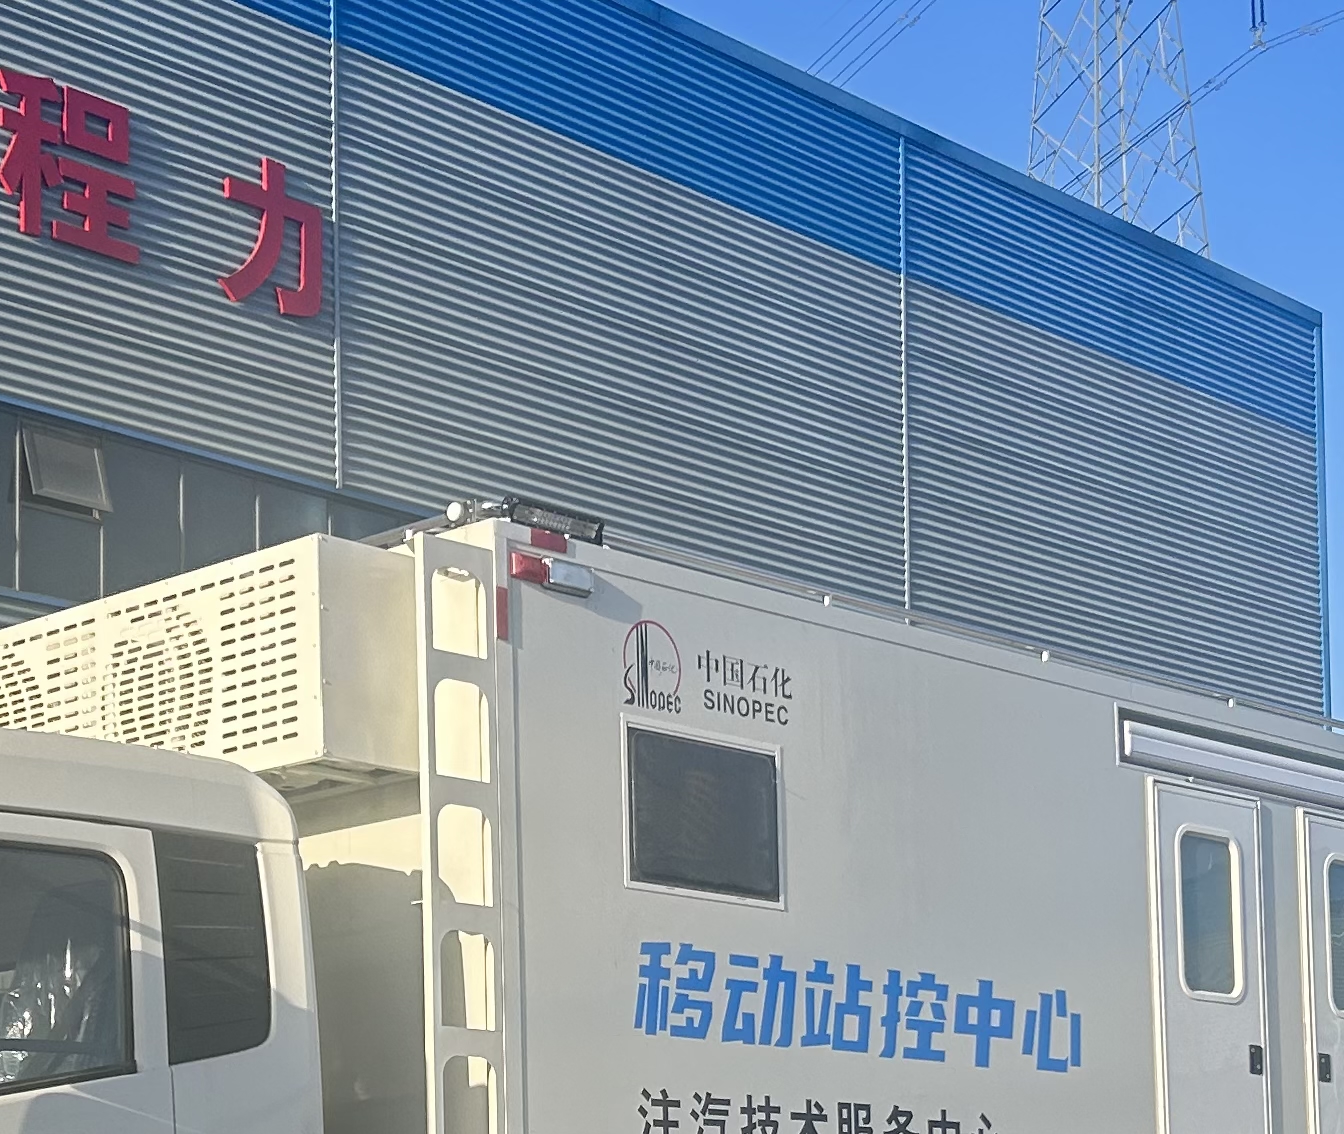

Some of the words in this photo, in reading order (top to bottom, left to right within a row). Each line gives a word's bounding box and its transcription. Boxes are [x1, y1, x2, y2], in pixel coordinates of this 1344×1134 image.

[697, 649, 794, 700] 中国石化
[703, 688, 789, 727] SINOPEC
[633, 941, 1082, 1073] 移动站控中心
